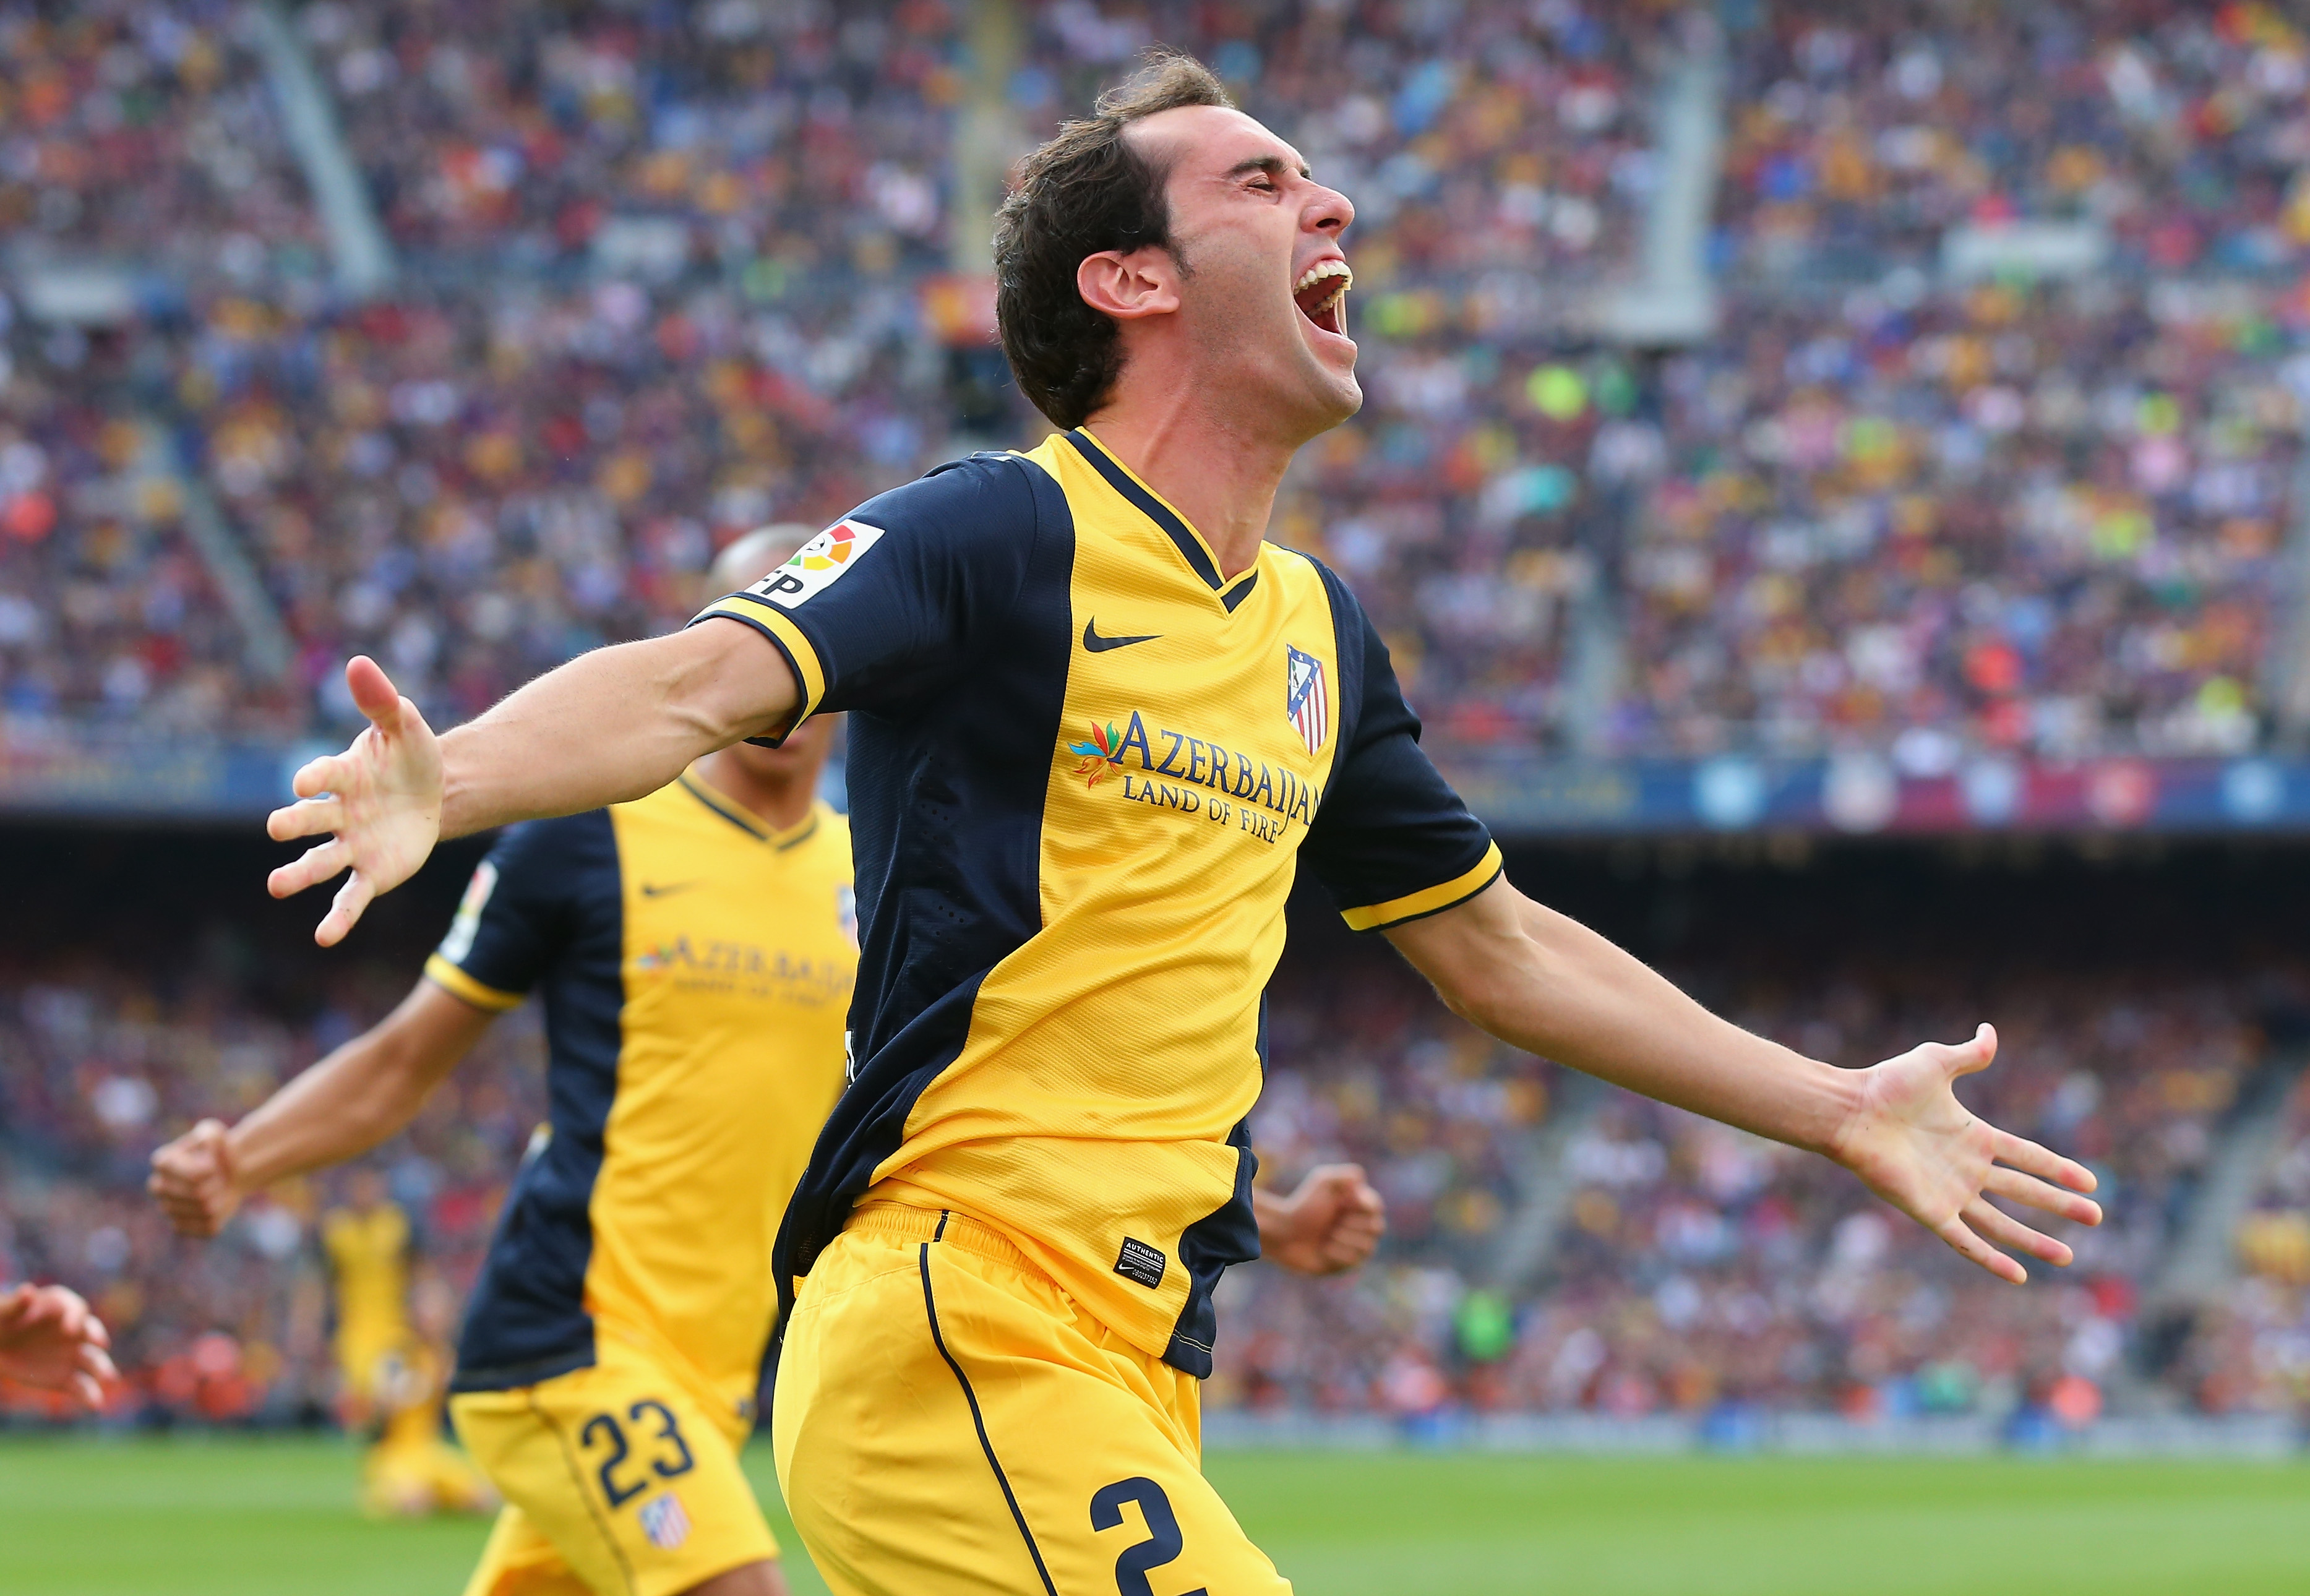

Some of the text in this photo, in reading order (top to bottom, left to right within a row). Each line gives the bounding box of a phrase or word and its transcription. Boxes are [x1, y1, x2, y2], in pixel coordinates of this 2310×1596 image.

[760, 570, 804, 595] P
[1123, 775, 1279, 844] LAND OF FIRE
[1126, 1242, 1164, 1263] AUTHENTIC
[581, 1400, 693, 1509] 23
[1090, 1477, 1209, 1596] 2
